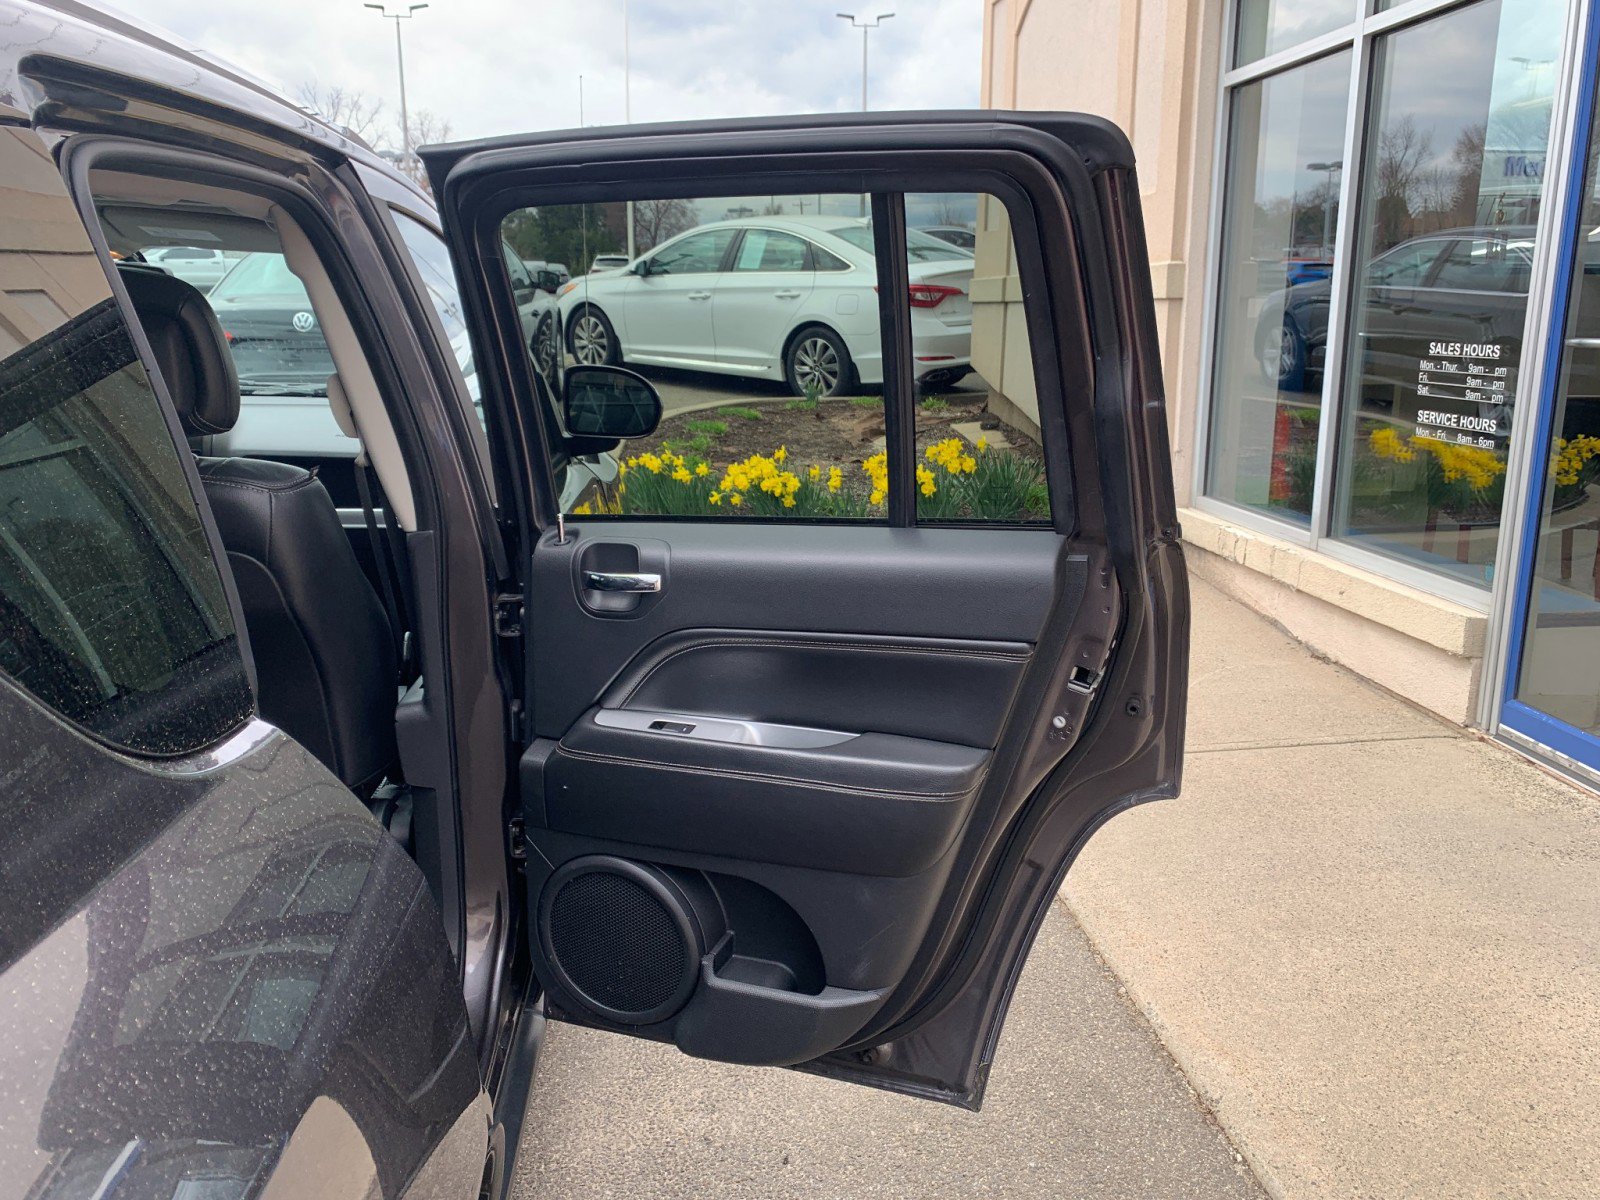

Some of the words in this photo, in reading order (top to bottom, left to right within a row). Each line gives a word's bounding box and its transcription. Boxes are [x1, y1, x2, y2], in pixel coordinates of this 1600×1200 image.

[1429, 342, 1460, 355] SALES
[1463, 344, 1500, 358] HOURS
[1420, 360, 1435, 370] Mon.
[1442, 361, 1458, 372] Thur.
[1468, 363, 1484, 373] 9am
[1494, 366, 1507, 376] pm
[1419, 372, 1428, 382] Fri.
[1466, 376, 1482, 386] 9am
[1492, 380, 1505, 389] pm
[1418, 385, 1429, 394] Sat.
[1465, 390, 1481, 400] 9am
[1492, 394, 1504, 403] pm
[1417, 410, 1458, 426] SERVICE
[1460, 416, 1496, 431] HOURS
[1416, 427, 1430, 436] Mon.
[1436, 430, 1446, 440] Fri.
[1457, 434, 1472, 444] 8am
[1478, 436, 1494, 448] 6pm
